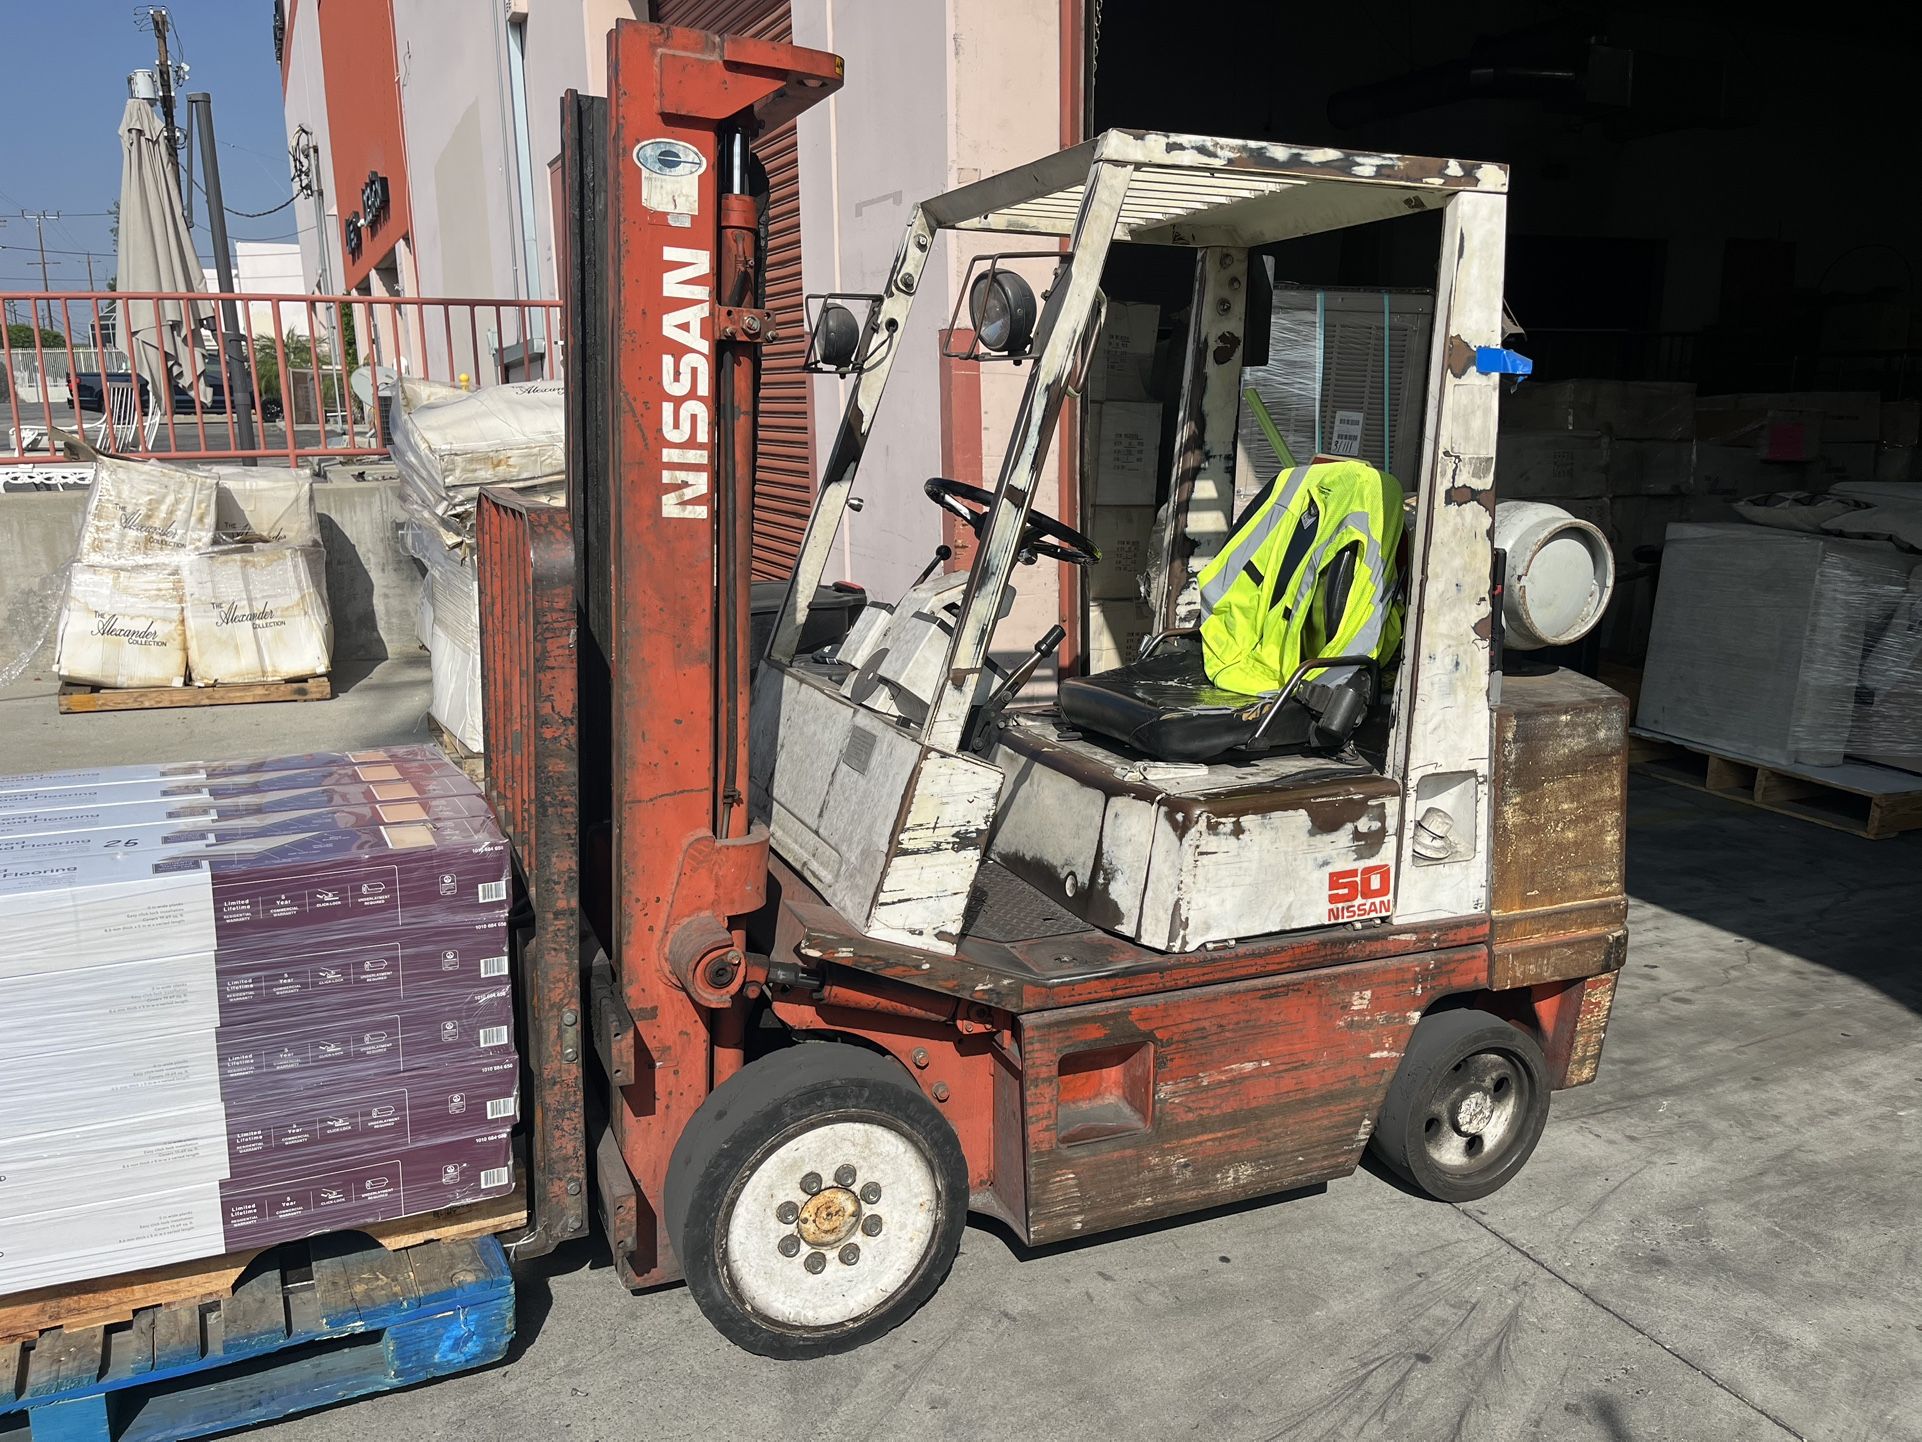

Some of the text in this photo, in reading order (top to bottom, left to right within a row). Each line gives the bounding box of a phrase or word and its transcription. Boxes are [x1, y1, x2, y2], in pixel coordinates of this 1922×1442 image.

[661, 245, 711, 519] NISSAN
[114, 503, 127, 512] THE
[120, 508, 178, 539] Alexander
[211, 602, 224, 610] THE
[94, 610, 106, 619] THE
[216, 601, 275, 628] Alexander
[91, 614, 159, 640] Alexander
[252, 621, 286, 630] COLLECTION
[128, 638, 167, 647] COLLECTION
[21, 839, 91, 849] Flooring
[103, 838, 139, 848] 25
[3, 866, 78, 878] Flooring
[1328, 864, 1391, 905] 50
[224, 899, 250, 907] Limited
[224, 904, 250, 912] Lifetime
[1328, 899, 1391, 922] NISSAN
[228, 978, 252, 986] Limited
[228, 1053, 253, 1062] Limited
[228, 1058, 254, 1066] Lifetime
[236, 1135, 263, 1143] Lifetime
[231, 1208, 257, 1216] Lifetime
[232, 1203, 256, 1212] Limited
